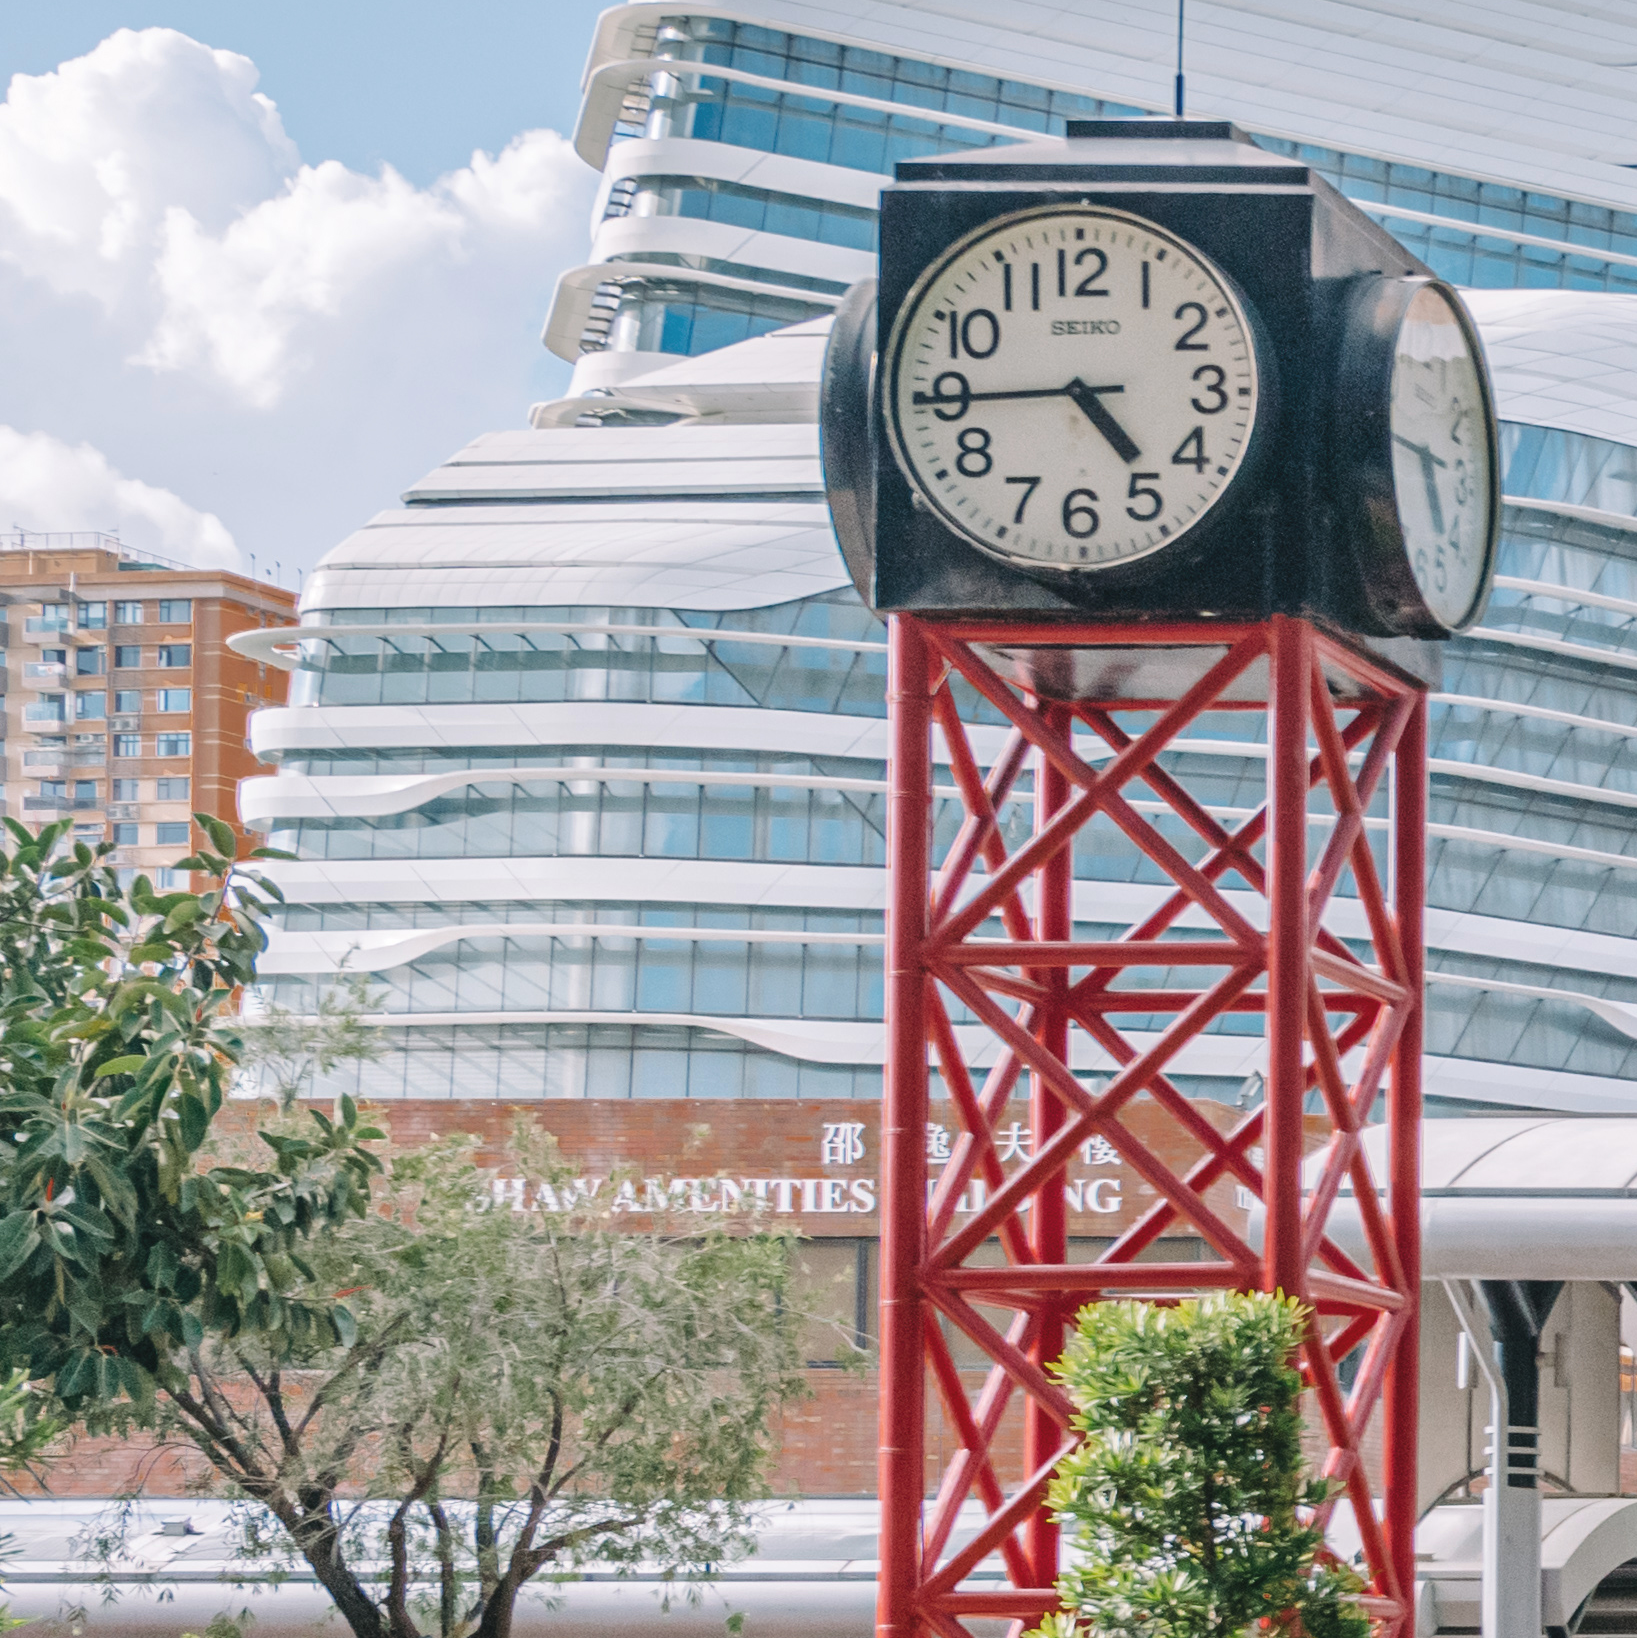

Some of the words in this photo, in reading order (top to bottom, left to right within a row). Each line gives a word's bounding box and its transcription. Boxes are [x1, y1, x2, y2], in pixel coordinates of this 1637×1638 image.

[1003, 262, 1040, 312] 11
[1057, 247, 1109, 297] 12
[1141, 260, 1151, 310] 1
[949, 308, 1001, 360] 10
[1051, 320, 1121, 336] SEIKO
[1174, 301, 1209, 351] 2
[932, 371, 971, 422] 9
[1190, 364, 1229, 414] 3
[955, 427, 993, 479] 8
[1171, 425, 1210, 474] 4
[1005, 476, 1042, 525] 7
[1061, 488, 1100, 540] 6
[1125, 472, 1164, 522] 5
[610, 1178, 876, 1213] AMENITIES
